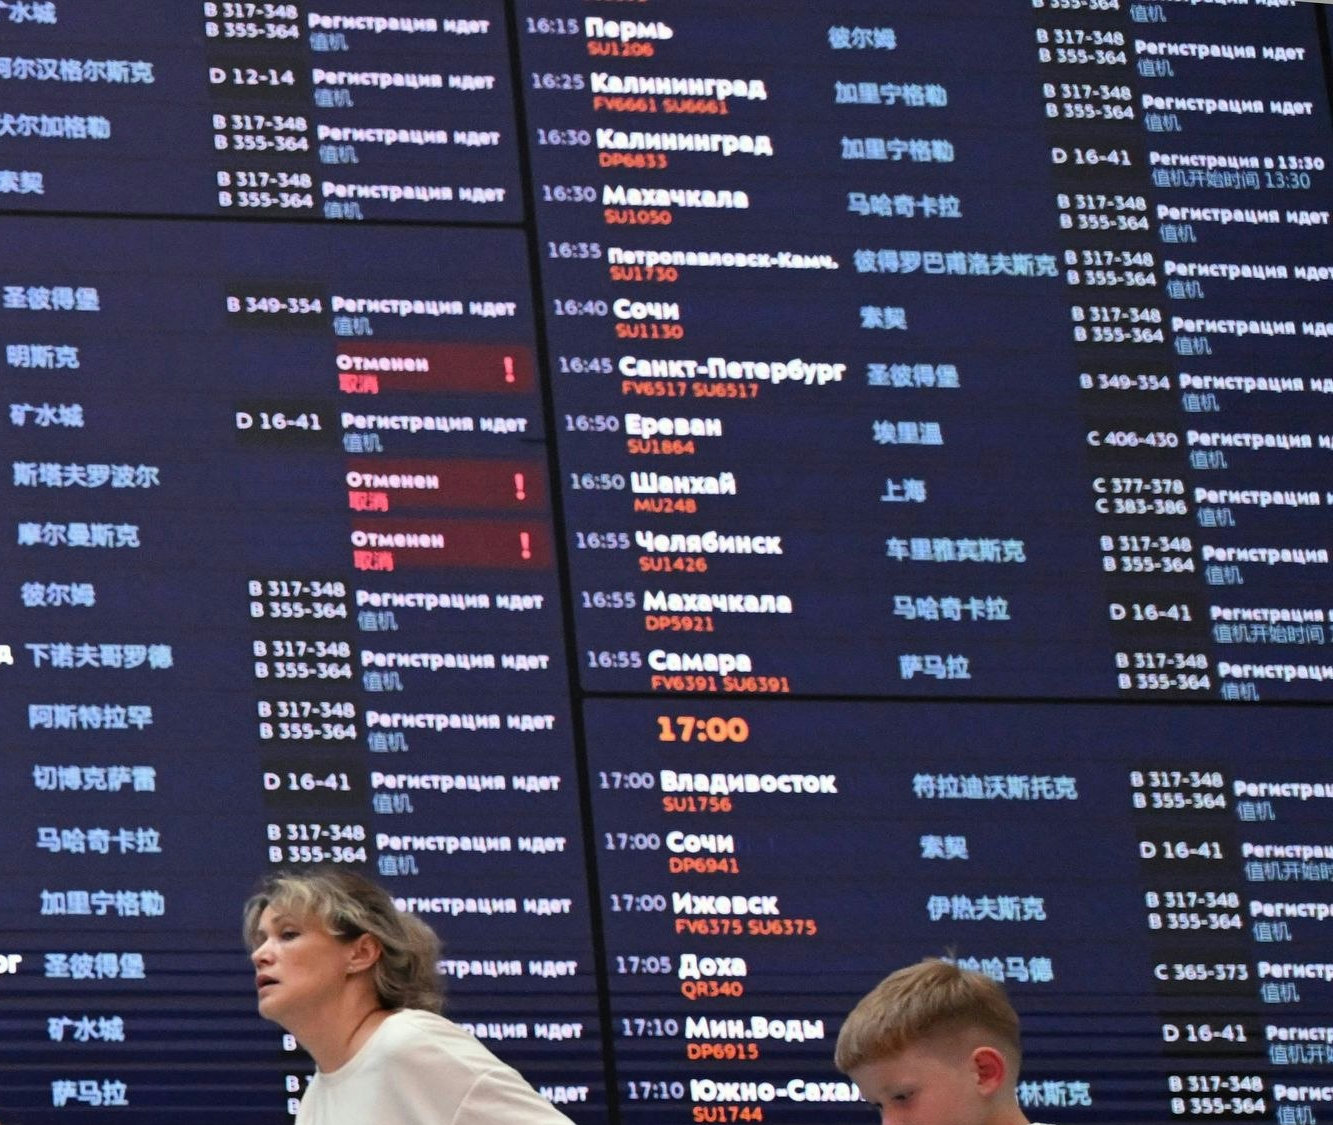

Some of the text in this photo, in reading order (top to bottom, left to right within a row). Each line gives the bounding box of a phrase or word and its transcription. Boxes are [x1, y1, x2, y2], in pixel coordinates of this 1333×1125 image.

[527, 17, 673, 43] 16:15 Пермь
[1135, 40, 1305, 61] Регистрация идет
[591, 72, 767, 101] Калининград
[603, 185, 749, 208] Махачкала
[613, 298, 679, 320] Сочи
[619, 356, 846, 387] Санкт-Петербург
[625, 414, 722, 439] Ереван
[1087, 431, 1100, 446] C
[631, 472, 736, 495] Шанхай
[881, 479, 926, 502] 上海
[635, 531, 782, 554] Челябинск
[643, 591, 792, 613] Махачкала
[648, 649, 751, 676] Самара
[658, 717, 749, 742] 17:00
[600, 770, 837, 795] 17:00 Владивосток
[666, 831, 734, 853] Сочи
[1139, 841, 1222, 859] D 16-41
[672, 892, 779, 915] Ижевск
[617, 954, 747, 979] 17:05 Доха
[622, 1016, 824, 1042] 17:10 Мин.Воды
[693, 1106, 762, 1122] SU1744
